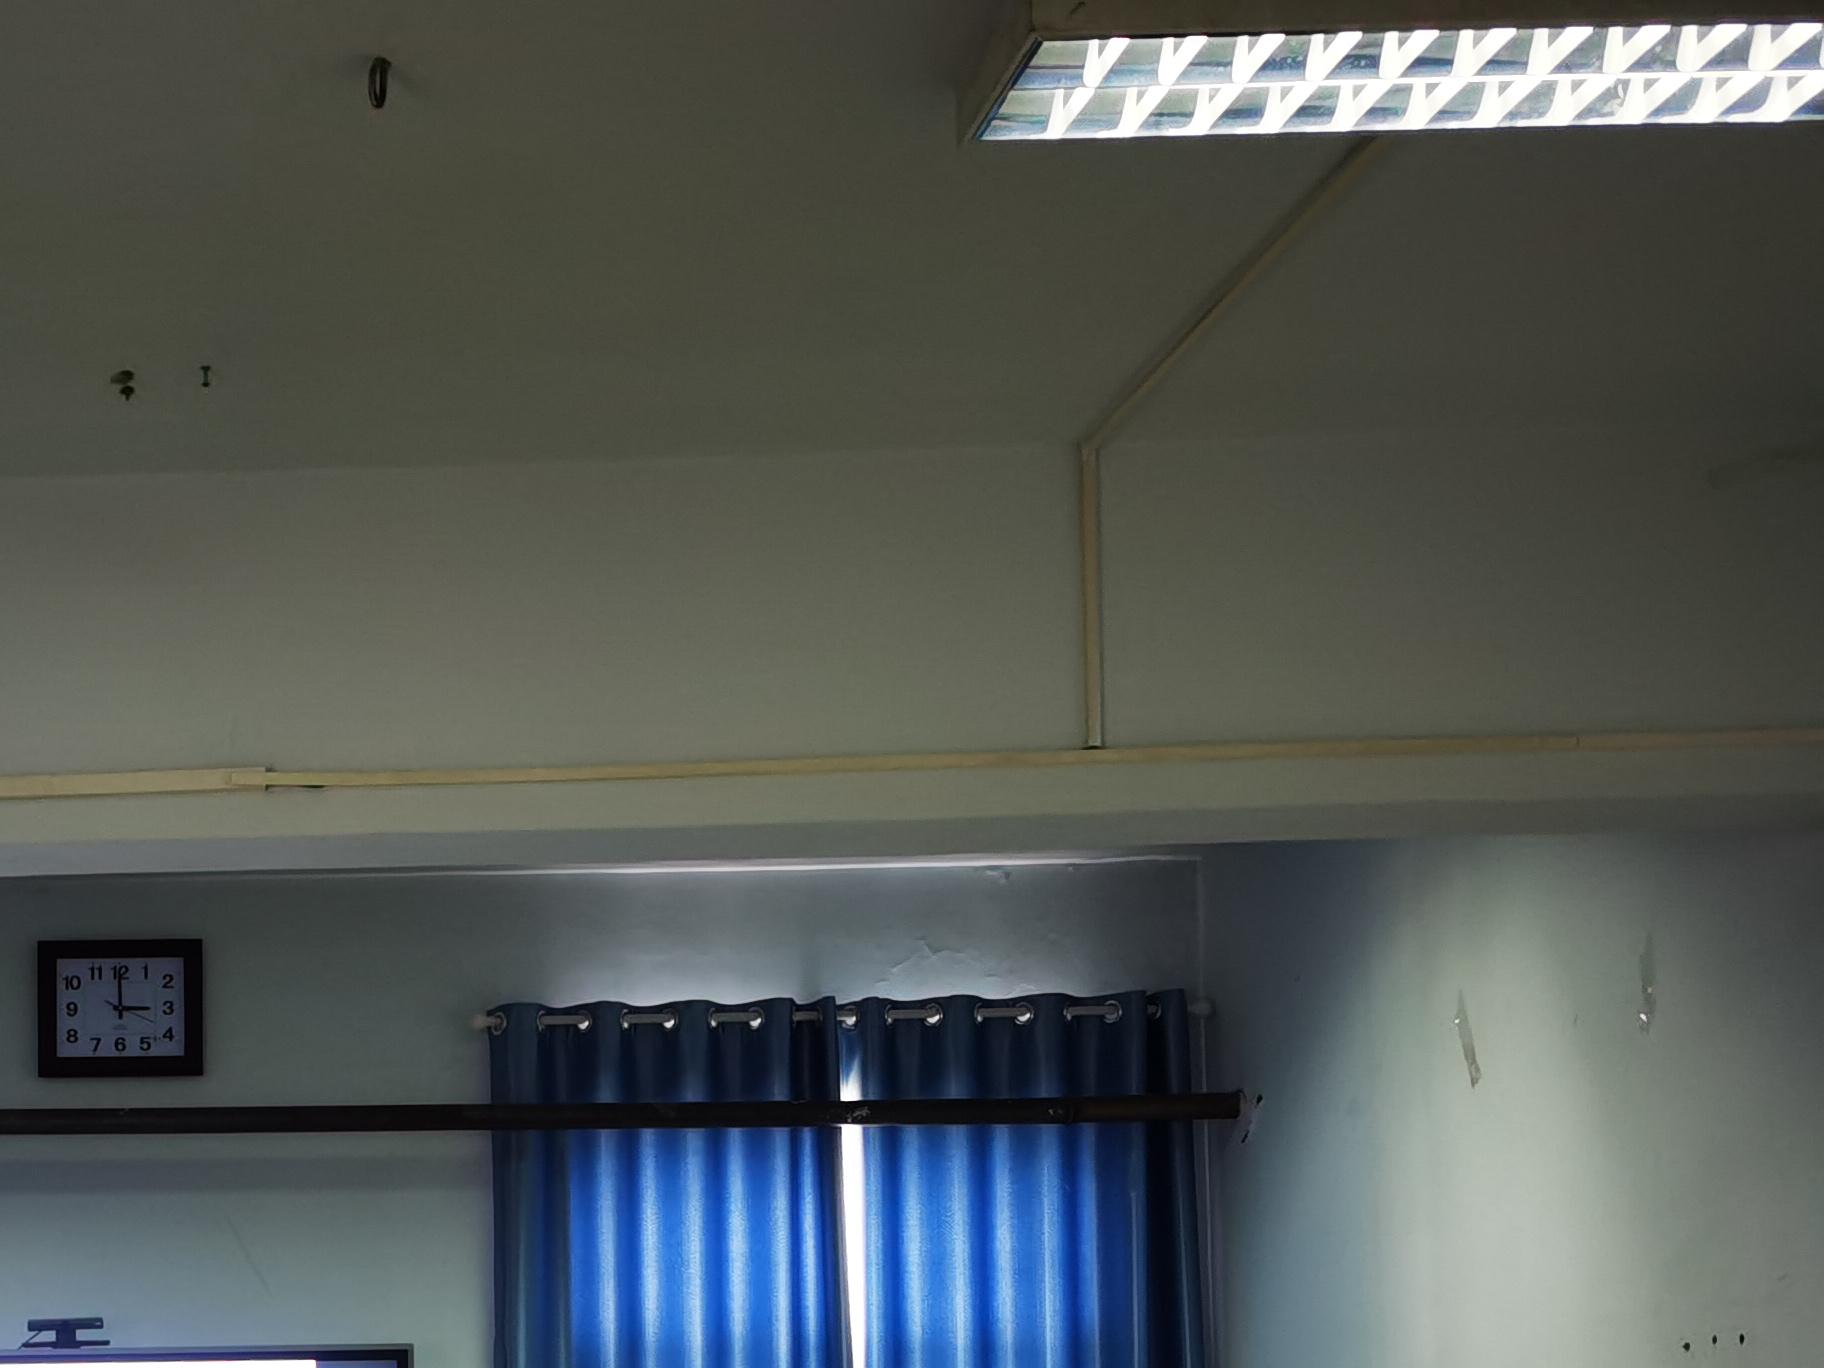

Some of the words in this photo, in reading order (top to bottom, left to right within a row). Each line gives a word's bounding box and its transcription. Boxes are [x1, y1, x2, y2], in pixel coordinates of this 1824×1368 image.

[88, 965, 103, 981] 11
[111, 965, 130, 981] 12
[141, 965, 149, 981] 1
[62, 975, 82, 991] 10
[161, 974, 175, 989] 2
[65, 1001, 79, 1017] 9
[161, 1000, 175, 1016] 3
[65, 1028, 79, 1044] 8
[161, 1026, 175, 1042] 4
[90, 1037, 102, 1054] 7
[114, 1036, 127, 1052] 6
[139, 1036, 152, 1052] 5
